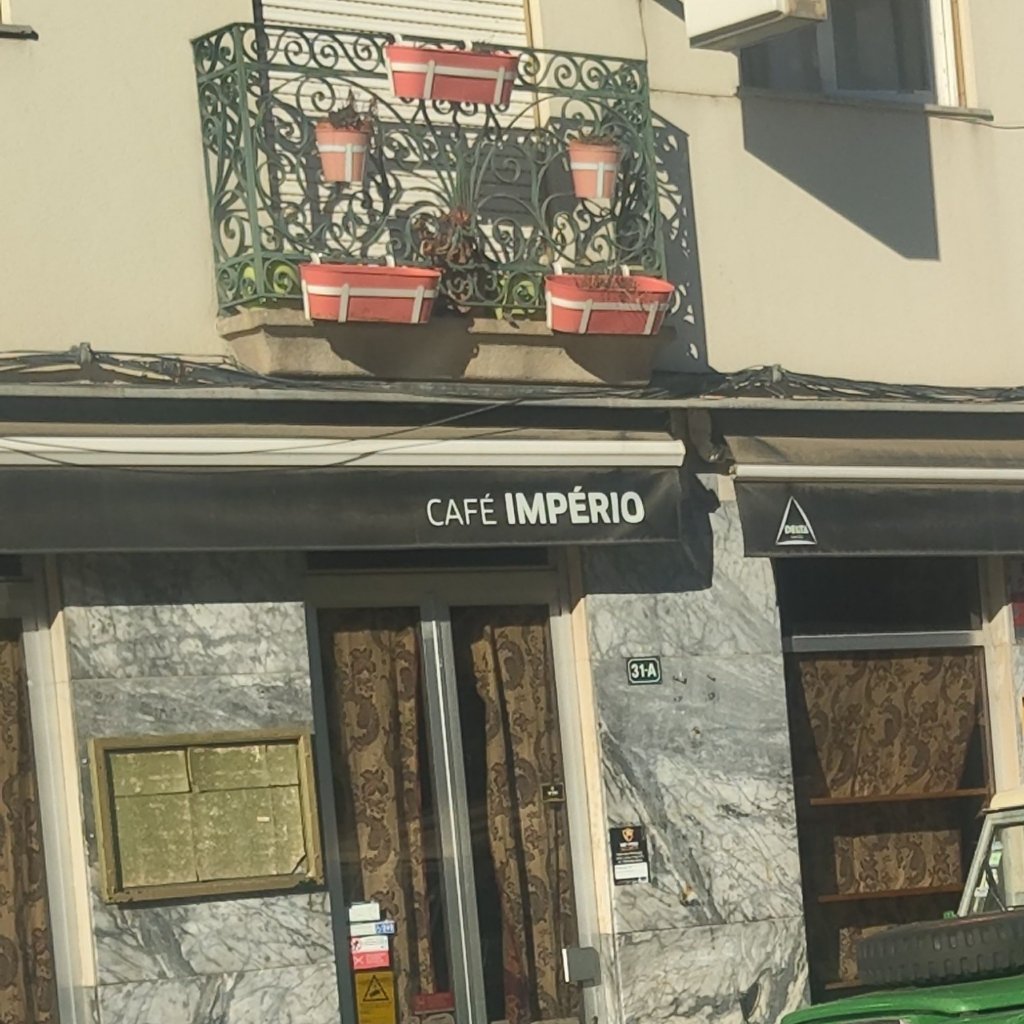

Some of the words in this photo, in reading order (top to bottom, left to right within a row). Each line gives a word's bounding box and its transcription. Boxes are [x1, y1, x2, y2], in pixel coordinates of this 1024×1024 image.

[426, 493, 497, 527] CAFÉ
[504, 485, 645, 525] IMPÉRIO
[630, 663, 657, 679] 31-A
